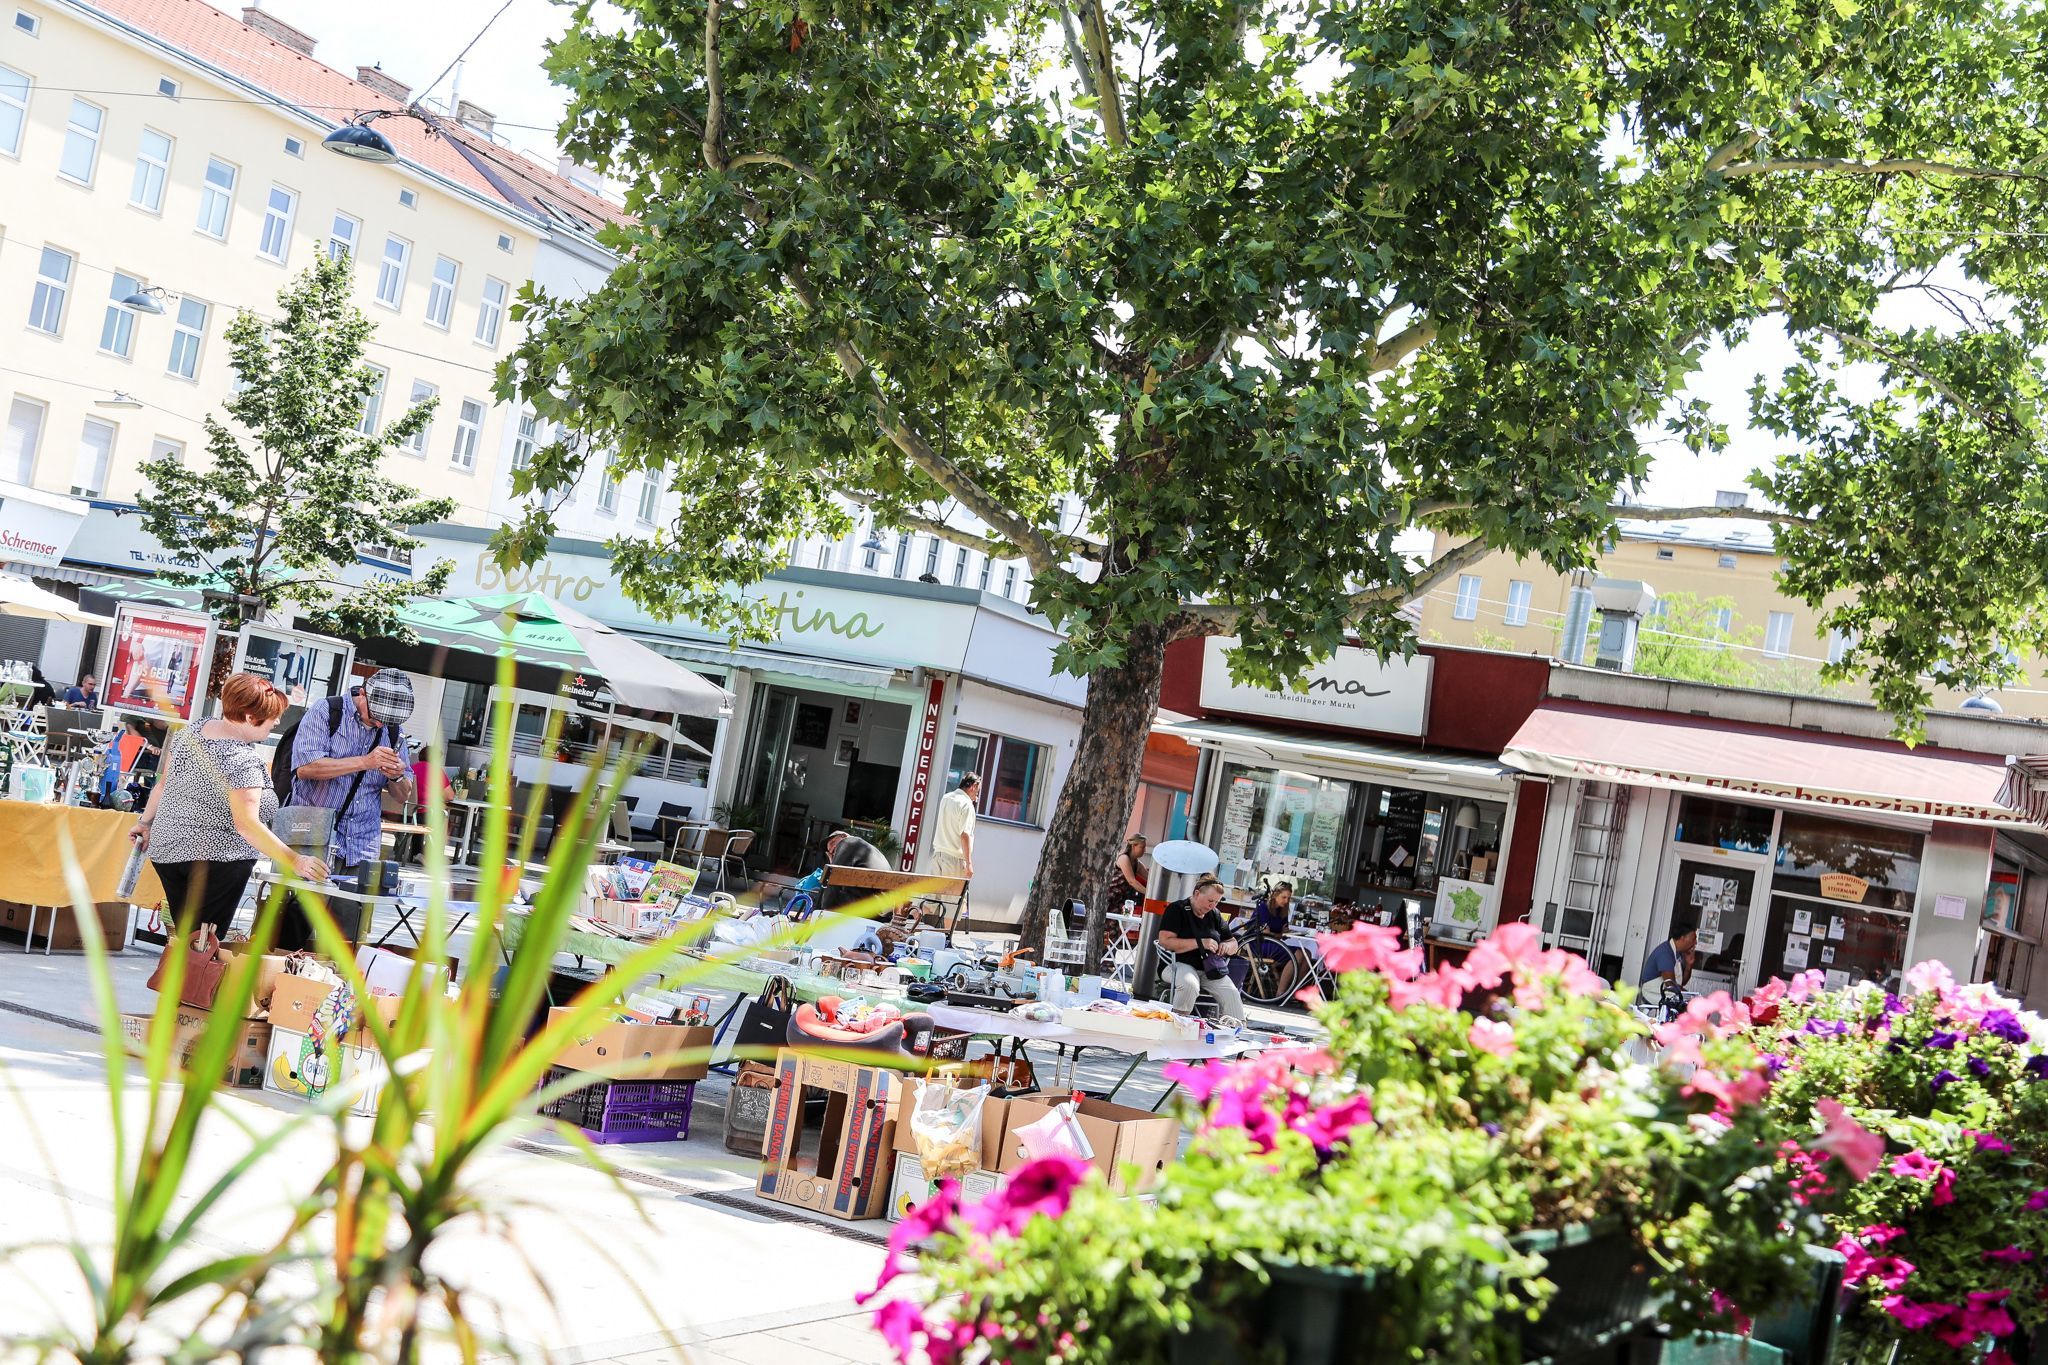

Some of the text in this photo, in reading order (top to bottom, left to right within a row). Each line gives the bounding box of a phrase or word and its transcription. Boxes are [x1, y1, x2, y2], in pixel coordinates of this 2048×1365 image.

[0, 529, 57, 556] Schremser
[525, 633, 565, 643] MARK
[561, 683, 596, 697] Heineken
[1279, 695, 1327, 706] Meidlinger
[1329, 699, 1356, 710] Markt
[902, 703, 939, 872] NEUERÖFFNU
[775, 1070, 793, 1121] PREMIUM
[840, 1143, 857, 1195] PREMIUM
[851, 1087, 869, 1141] BANANAS
[861, 1147, 877, 1198] PREMIUM
